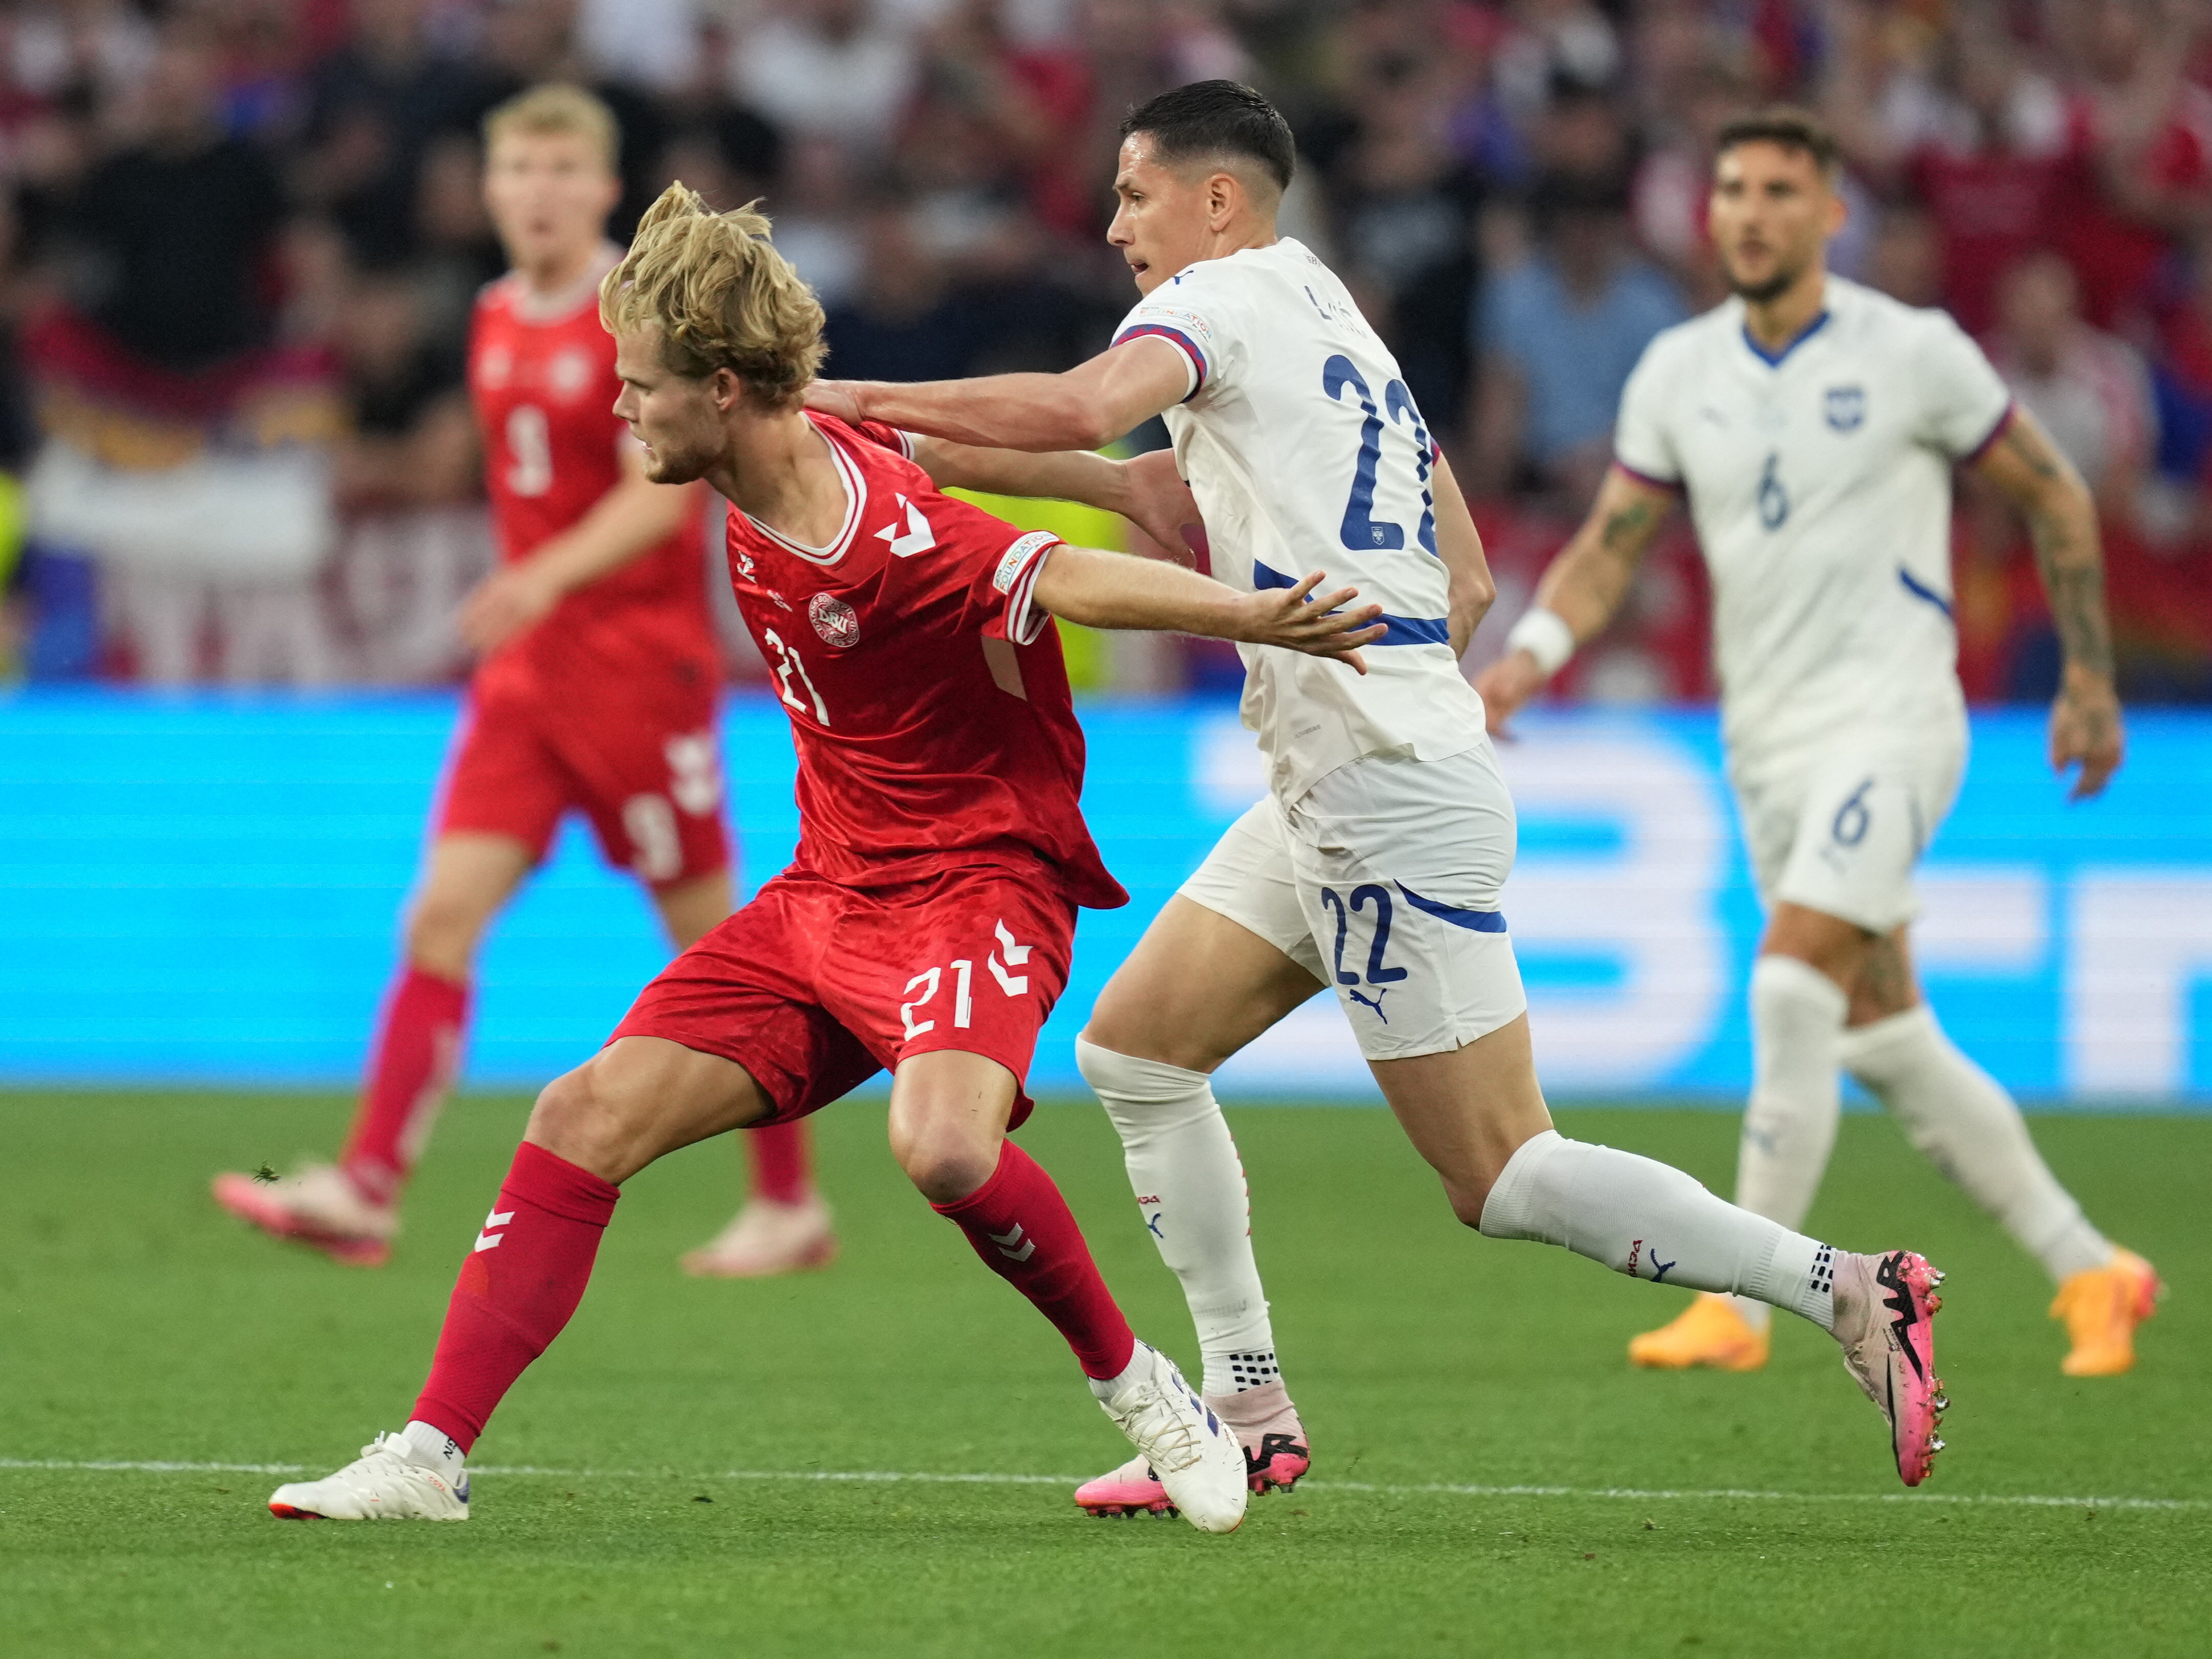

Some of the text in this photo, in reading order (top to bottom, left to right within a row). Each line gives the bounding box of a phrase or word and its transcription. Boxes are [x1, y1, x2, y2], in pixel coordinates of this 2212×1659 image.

[1323, 354, 1440, 559] 22
[1757, 453, 1790, 531] 6
[818, 607, 849, 634] DBU
[764, 628, 830, 727] 21
[1833, 778, 1872, 846] 6
[1321, 884, 1408, 985] 22
[900, 959, 972, 1042] 21
